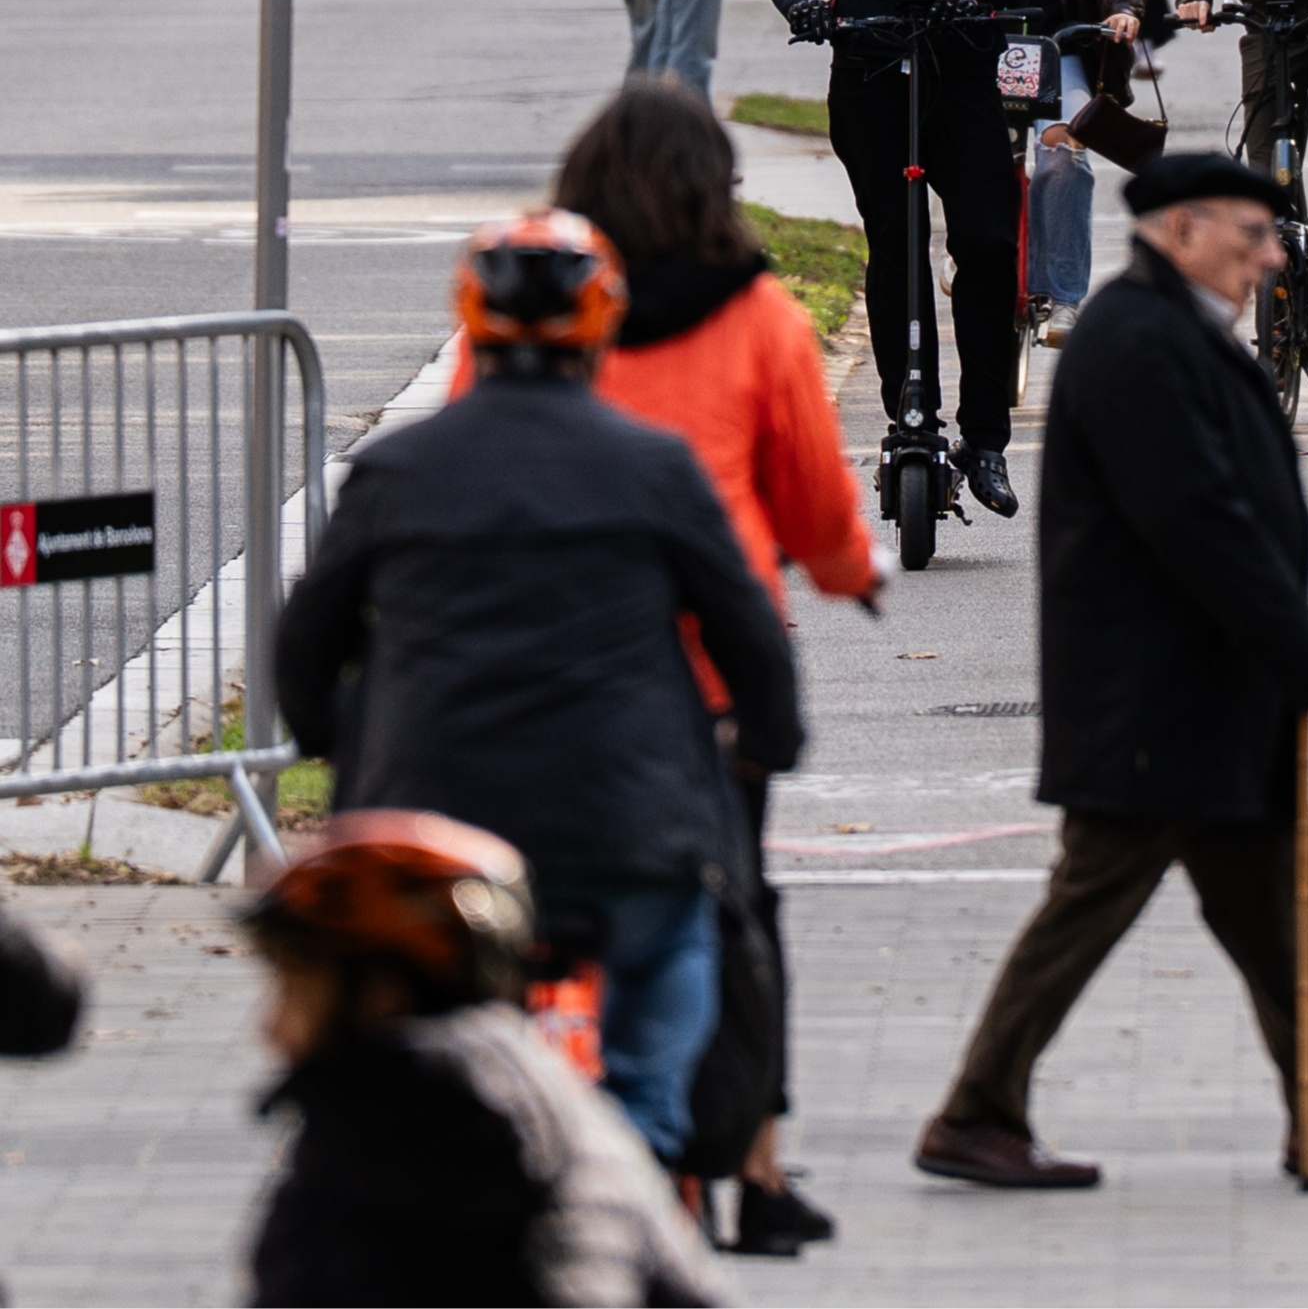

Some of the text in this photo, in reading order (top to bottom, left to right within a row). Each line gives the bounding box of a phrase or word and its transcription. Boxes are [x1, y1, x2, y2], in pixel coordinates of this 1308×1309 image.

[37, 523, 153, 559] Ajuntament de Barcelona
